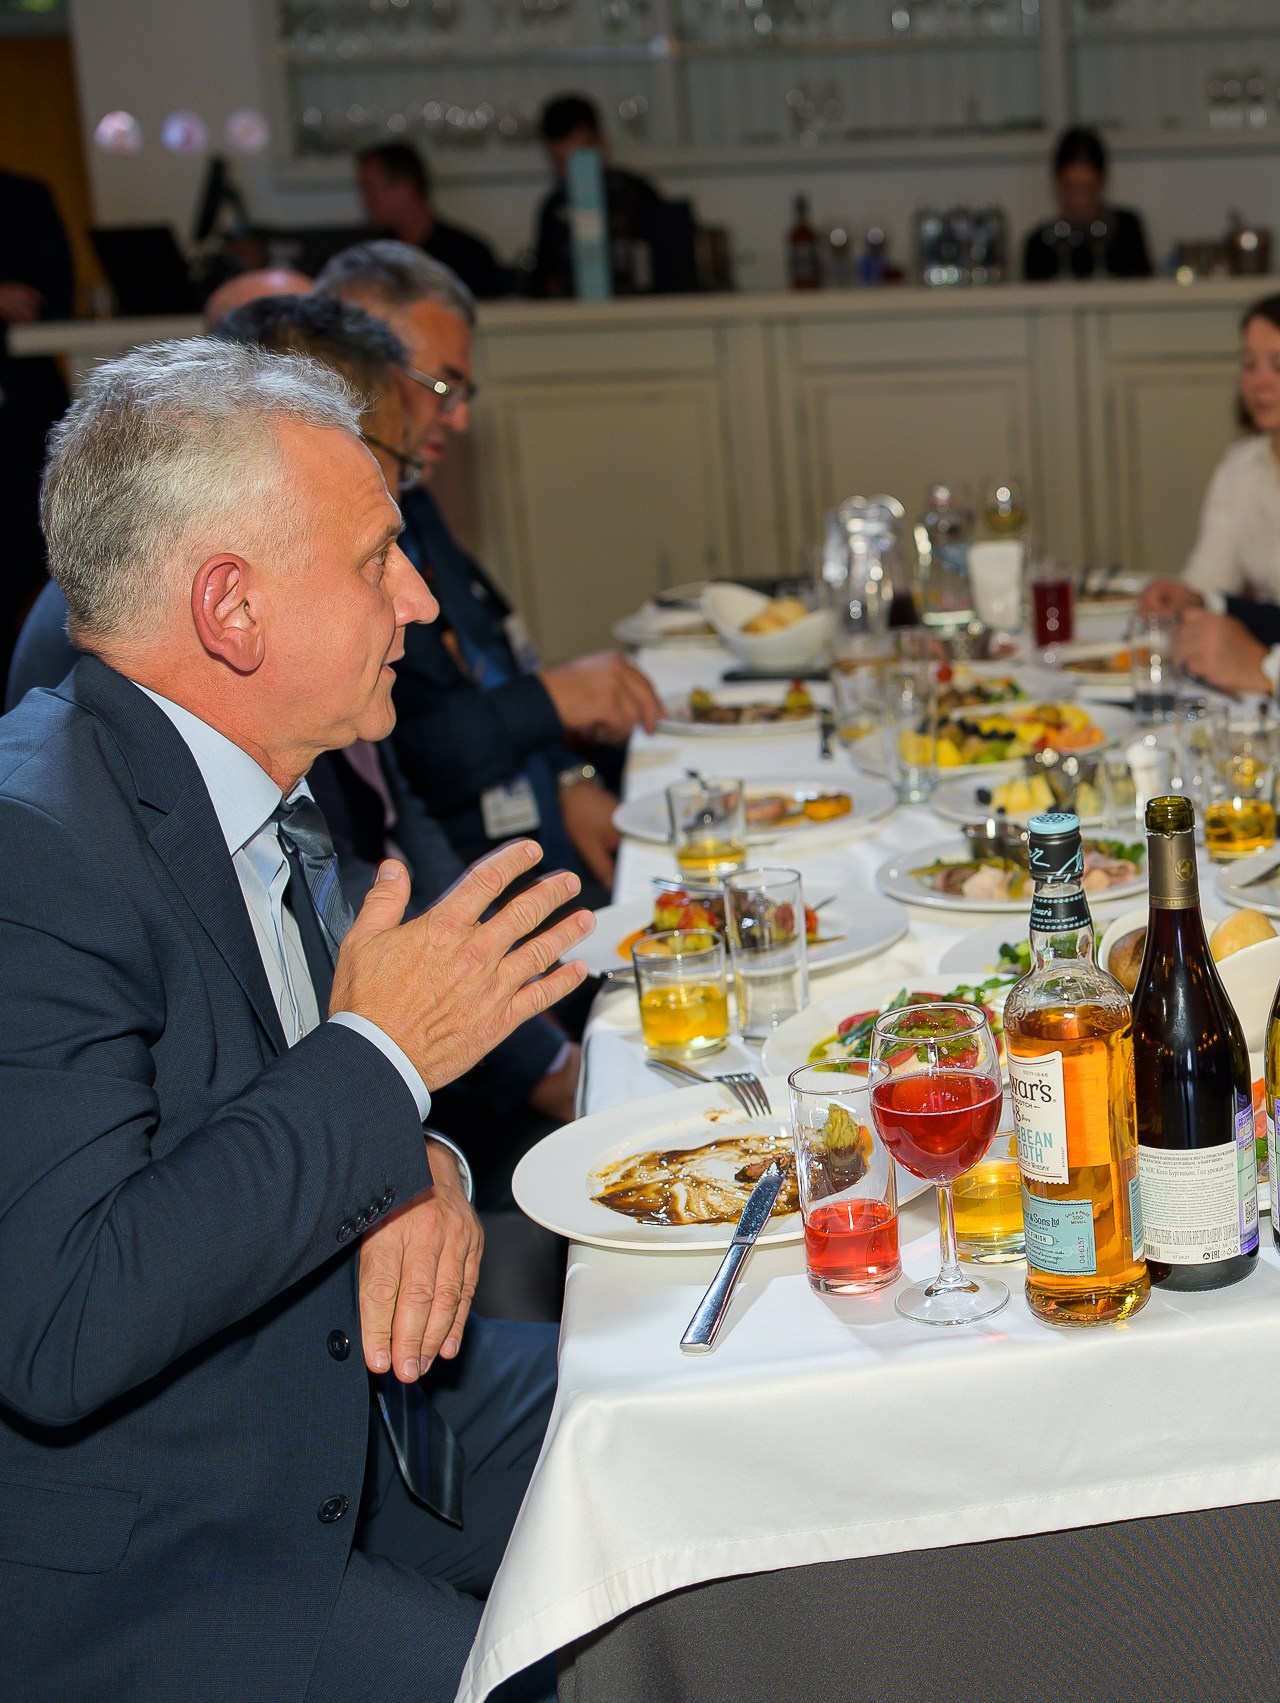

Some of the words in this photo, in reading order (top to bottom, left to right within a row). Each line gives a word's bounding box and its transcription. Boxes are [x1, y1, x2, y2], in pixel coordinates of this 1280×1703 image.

[1033, 1212, 1051, 1227] Sons
[1051, 1217, 1060, 1228] Ltd
[1030, 1230, 1047, 1243] FINISH
